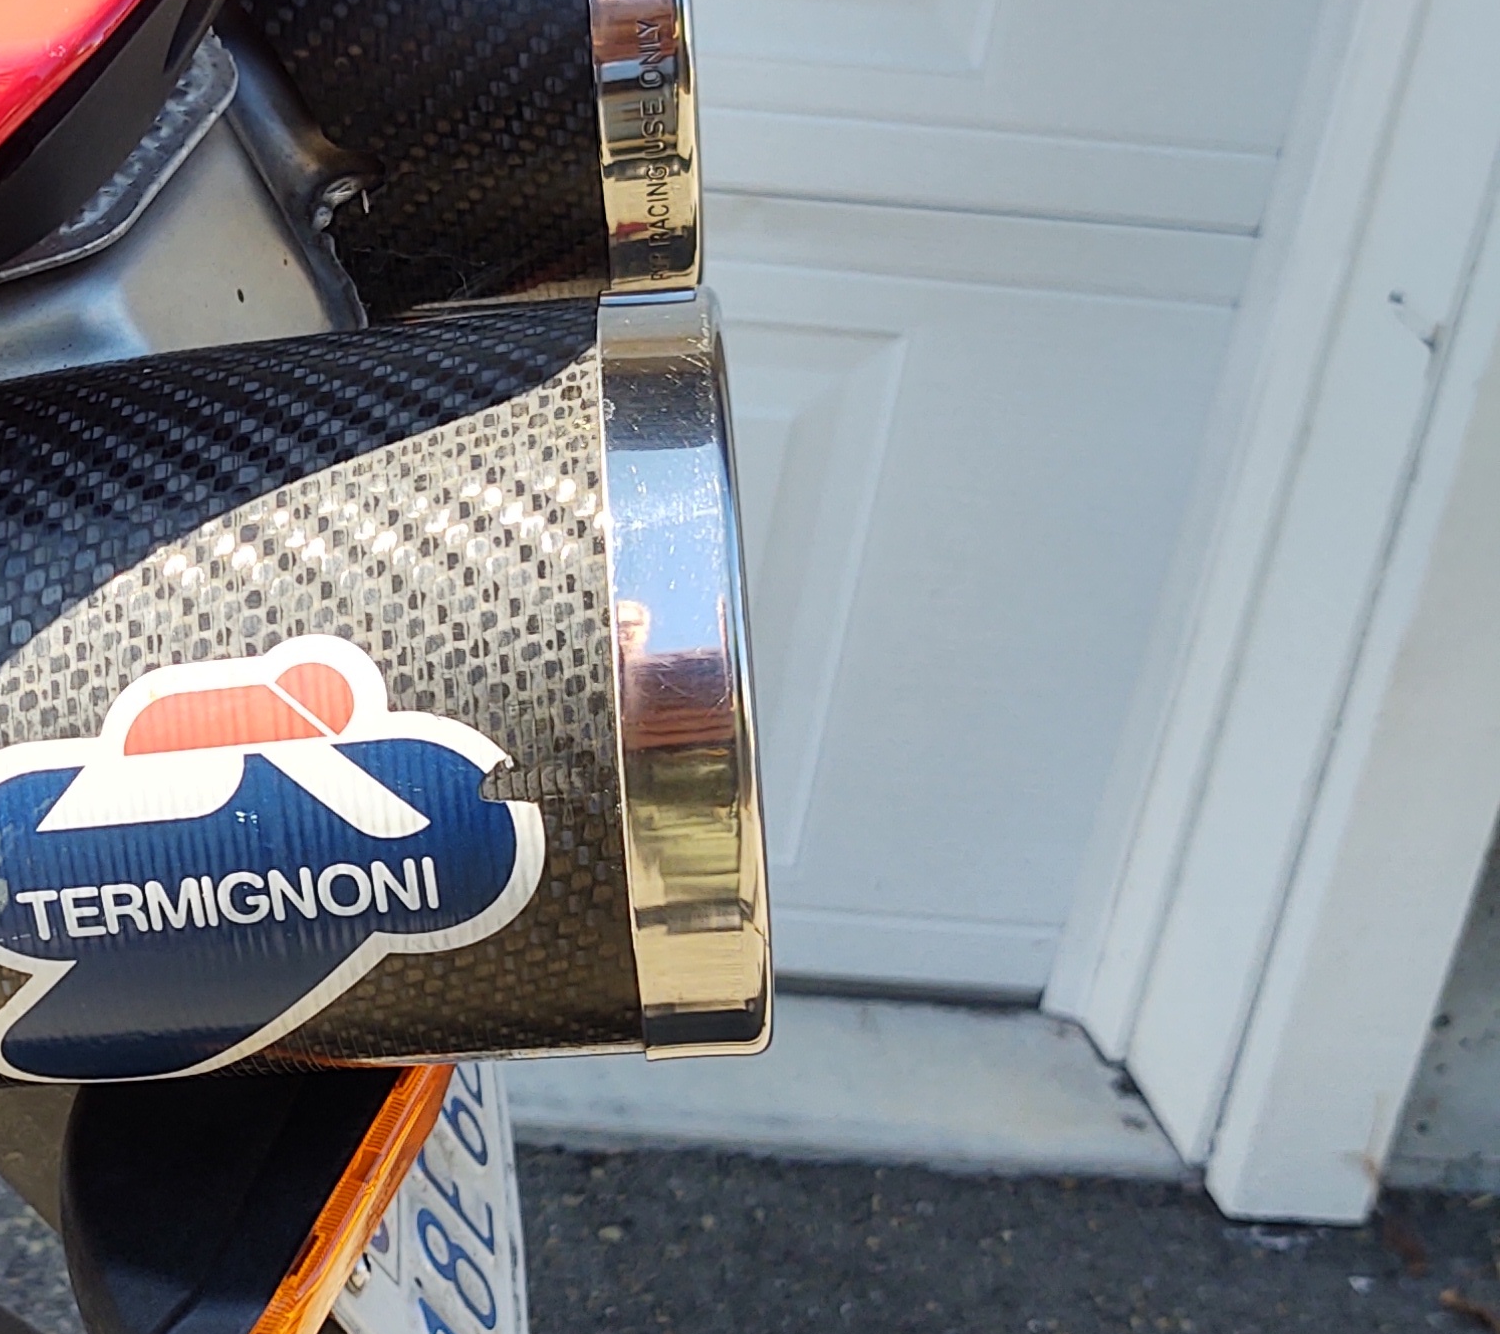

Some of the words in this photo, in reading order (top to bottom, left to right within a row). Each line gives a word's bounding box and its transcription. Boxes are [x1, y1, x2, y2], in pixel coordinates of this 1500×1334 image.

[637, 20, 664, 88] ONLY
[640, 99, 665, 156] USE
[647, 166, 670, 246] RACING
[16, 857, 439, 941] TERMIGNONI
